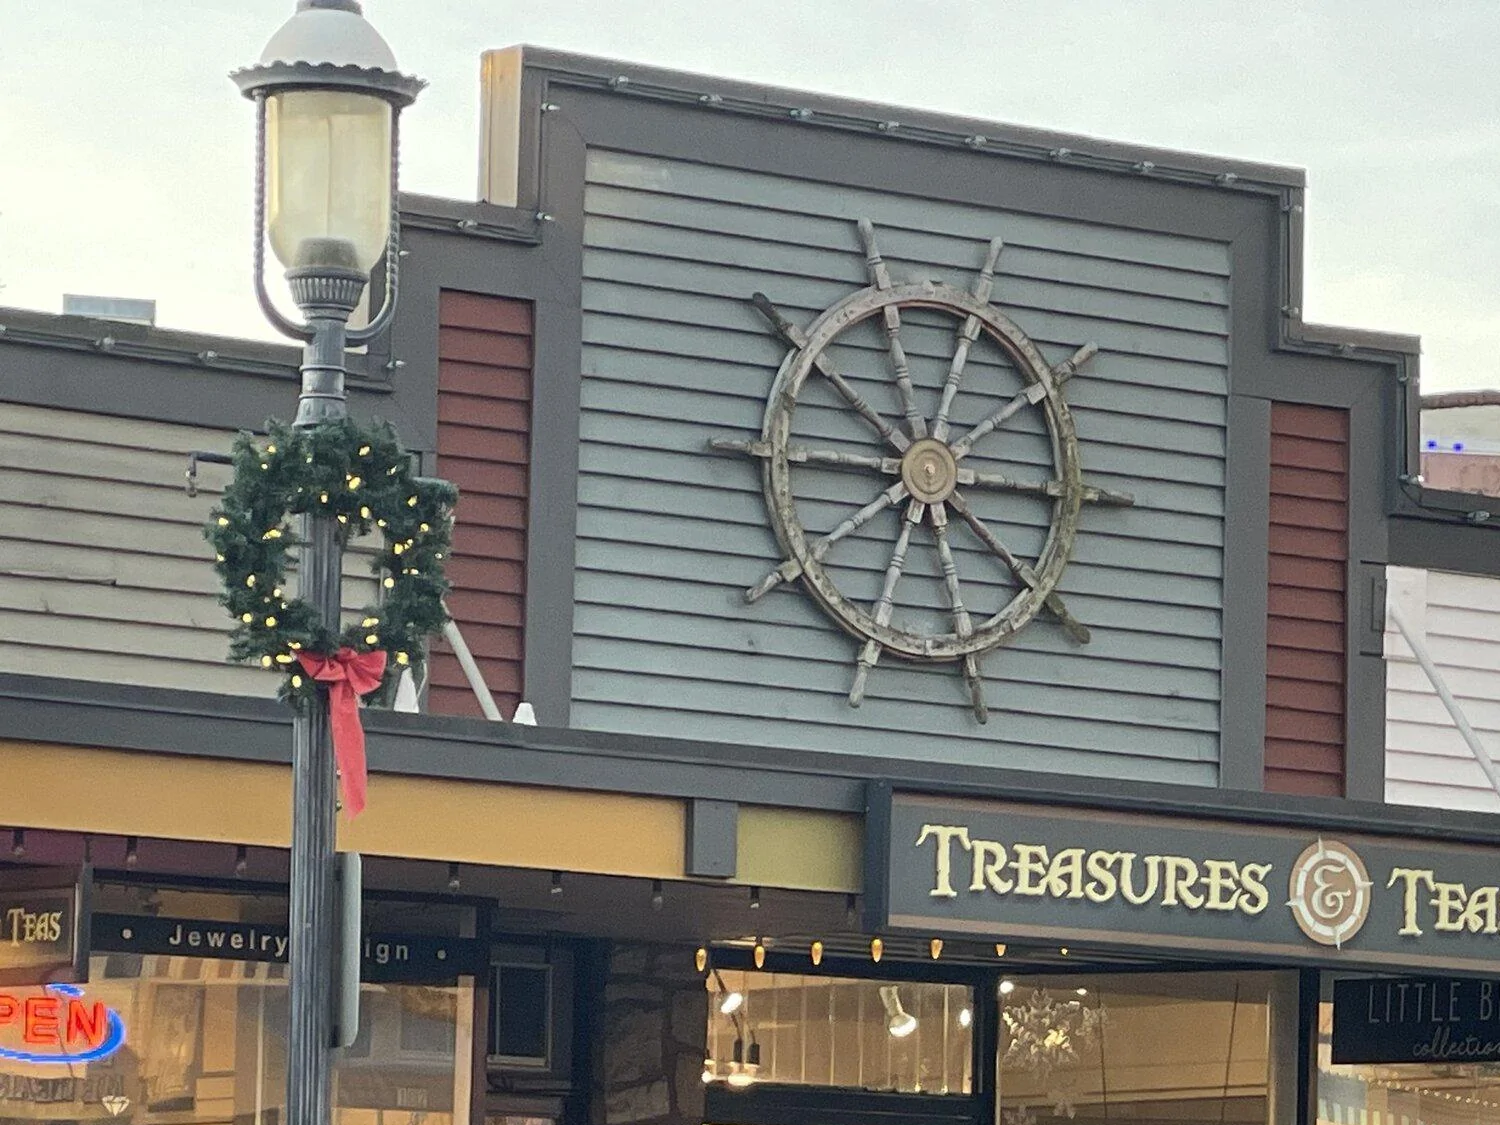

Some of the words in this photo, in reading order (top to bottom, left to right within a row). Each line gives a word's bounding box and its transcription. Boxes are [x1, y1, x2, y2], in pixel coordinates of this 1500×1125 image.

[169, 924, 289, 957] Jewelry
[364, 938, 409, 964] ign
[1368, 982, 1462, 1024] LITTLE
